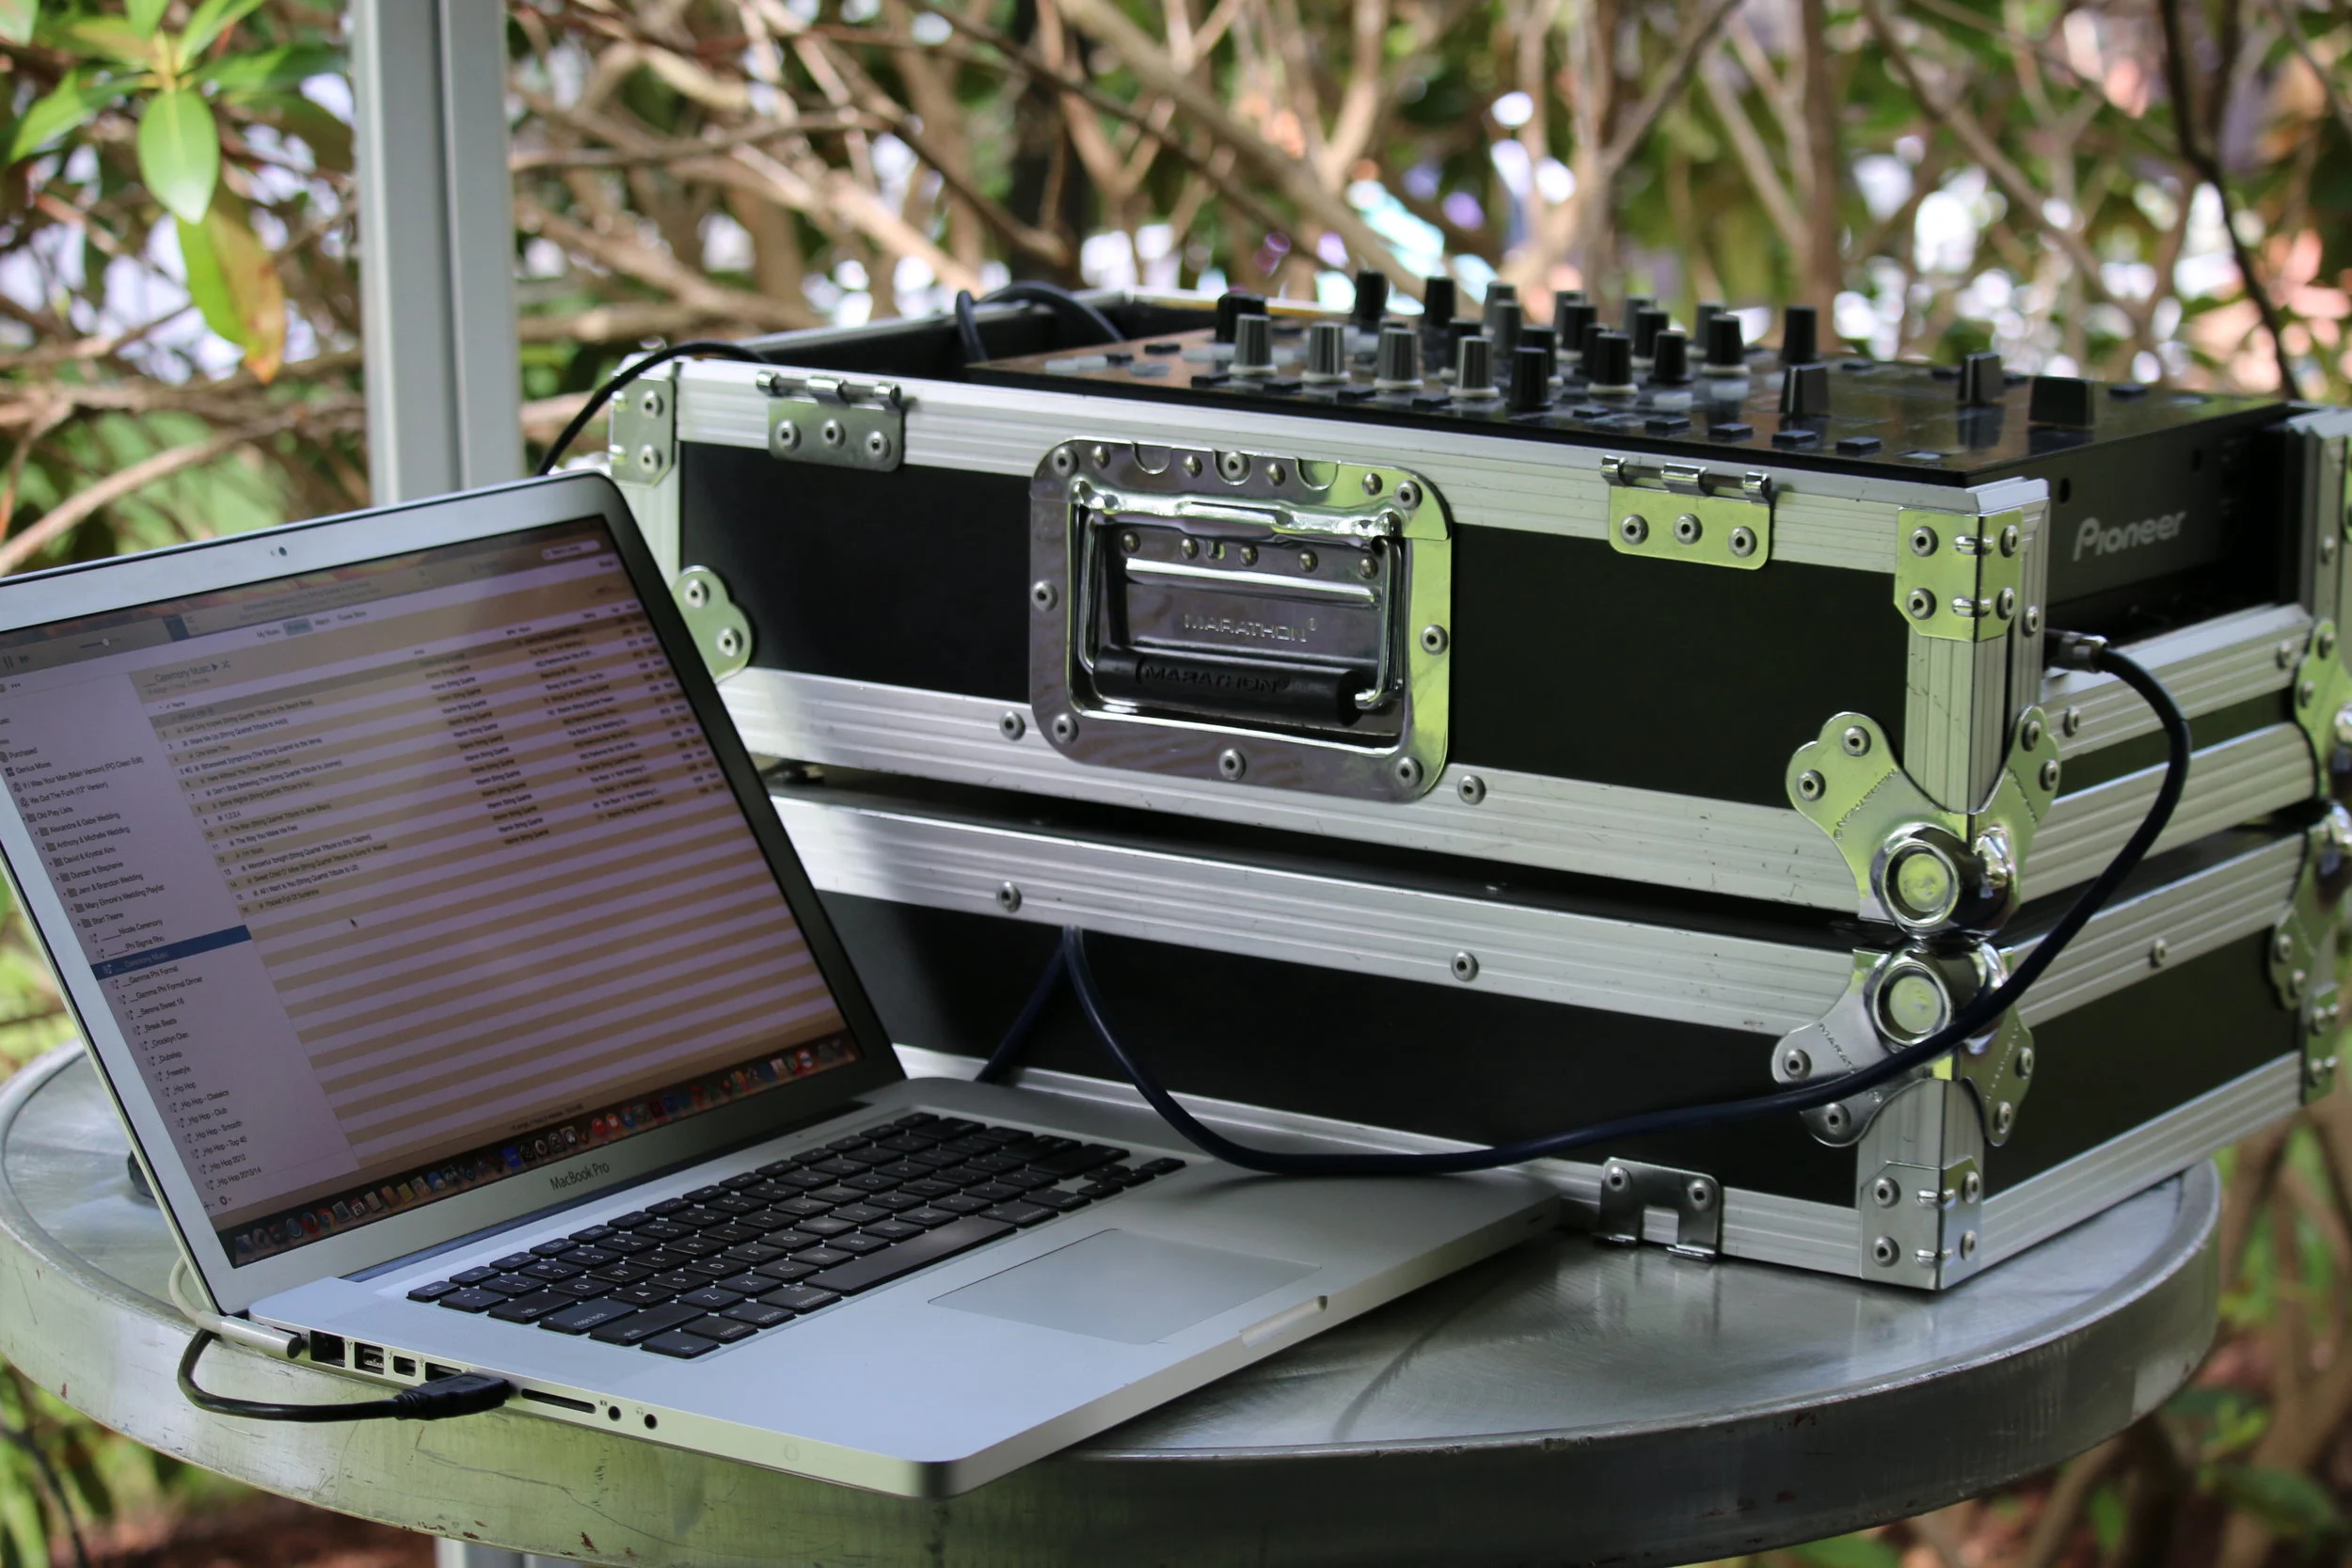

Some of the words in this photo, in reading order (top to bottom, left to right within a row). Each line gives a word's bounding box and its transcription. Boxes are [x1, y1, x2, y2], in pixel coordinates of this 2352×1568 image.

[2073, 511, 2187, 562] Pioneer
[549, 1166, 594, 1191] MacBook
[592, 1163, 610, 1177] Pro
